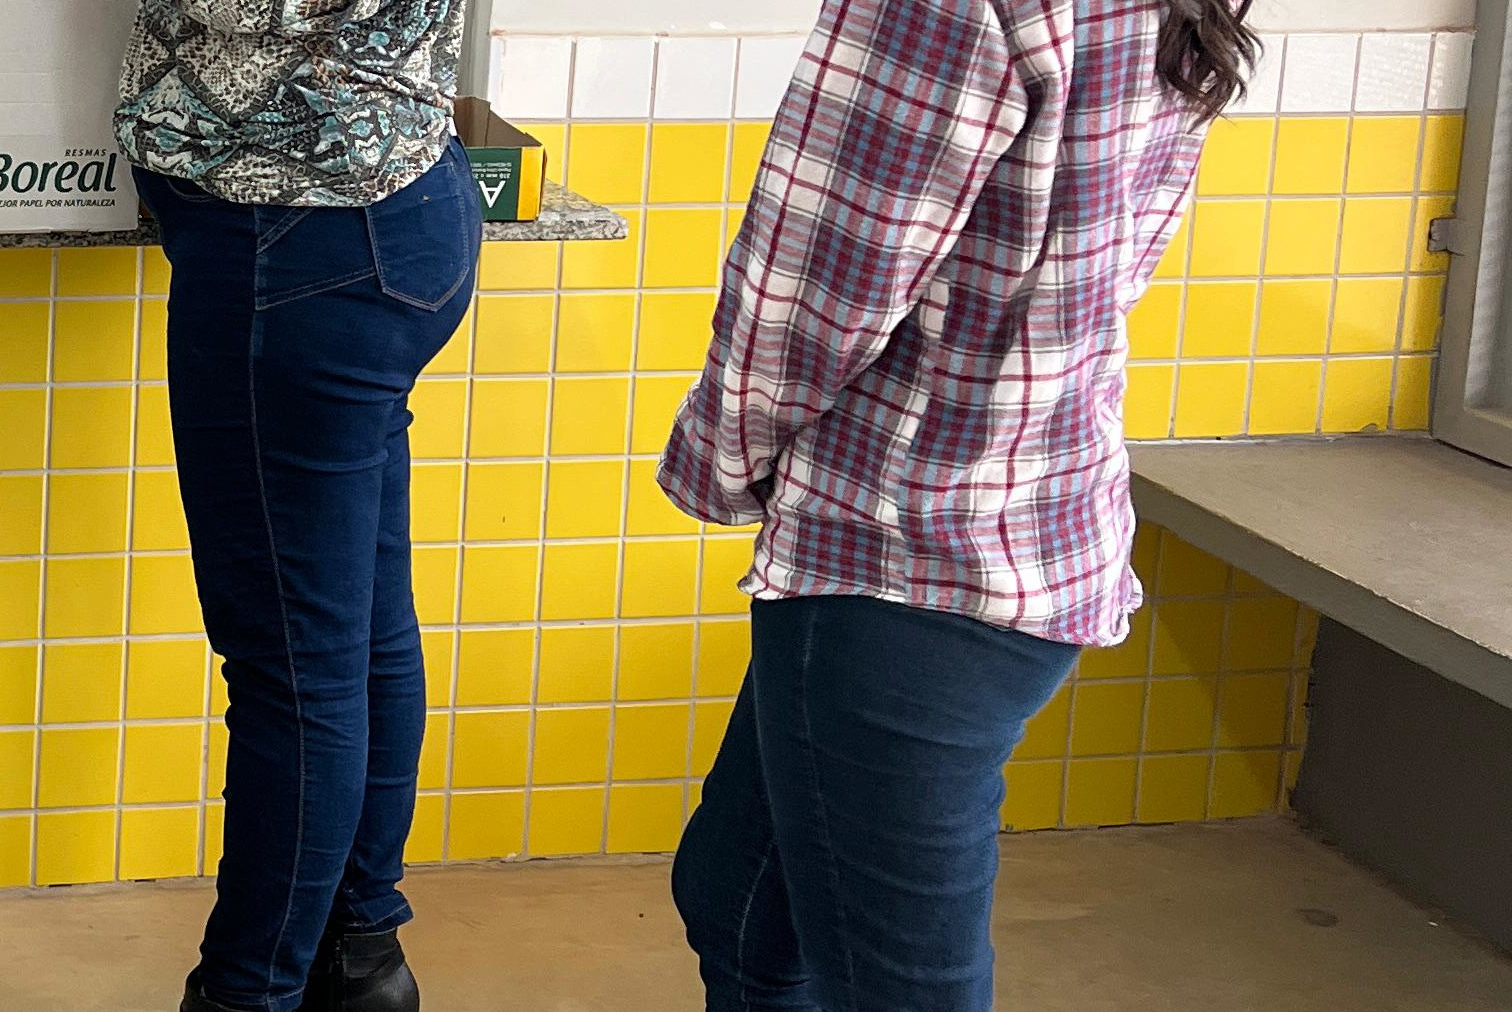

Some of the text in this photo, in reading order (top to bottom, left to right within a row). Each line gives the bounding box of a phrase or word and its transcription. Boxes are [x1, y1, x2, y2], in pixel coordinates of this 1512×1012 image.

[65, 149, 108, 157] RESMAS
[45, 199, 62, 207] POR
[64, 199, 116, 207] NATURALEZA
